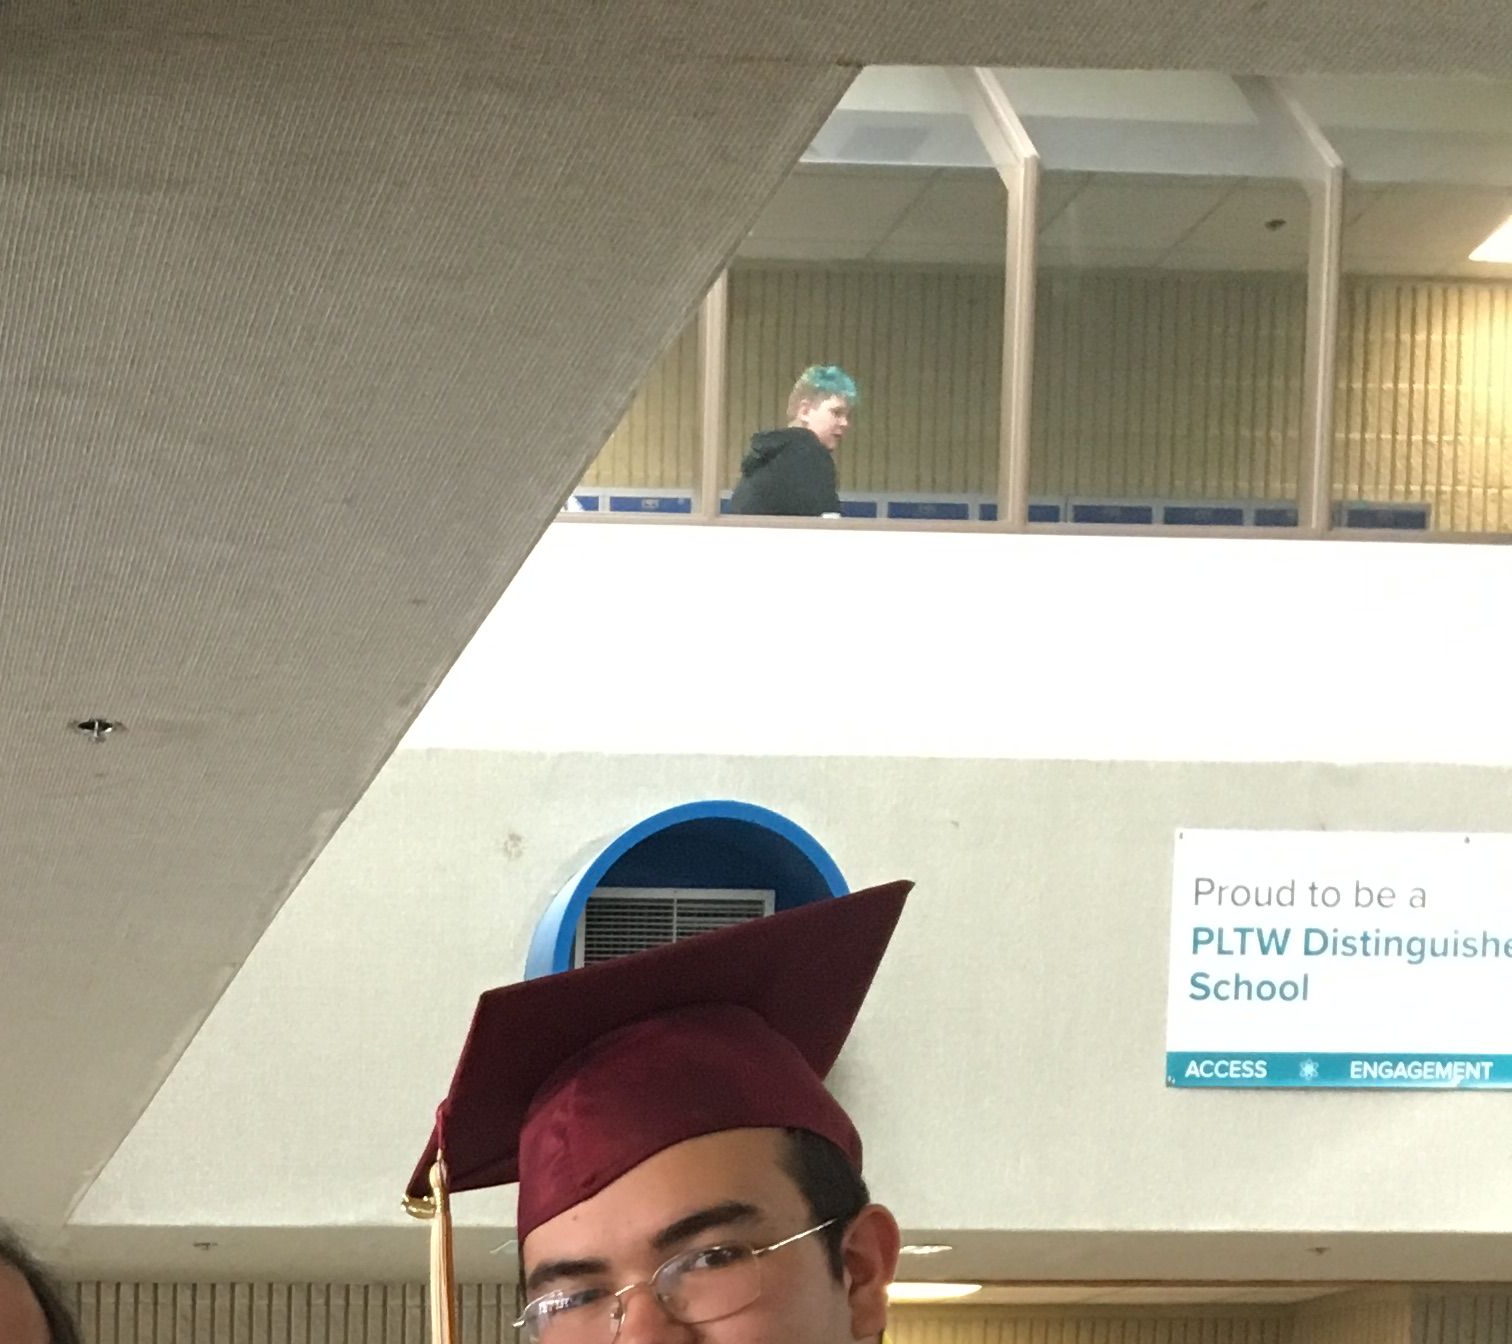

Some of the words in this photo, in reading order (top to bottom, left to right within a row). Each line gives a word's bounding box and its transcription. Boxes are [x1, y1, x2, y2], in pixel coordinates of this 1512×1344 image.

[1194, 877, 1295, 907] Proud
[1309, 881, 1341, 907] to
[1355, 880, 1396, 908] be
[1409, 886, 1426, 908] a
[1192, 926, 1291, 956] PLTW
[1303, 927, 1512, 964] Distinguish
[1189, 971, 1309, 1001] School
[1184, 1060, 1267, 1079] ACCESS
[1350, 1060, 1494, 1080] ENGAGEMENT
